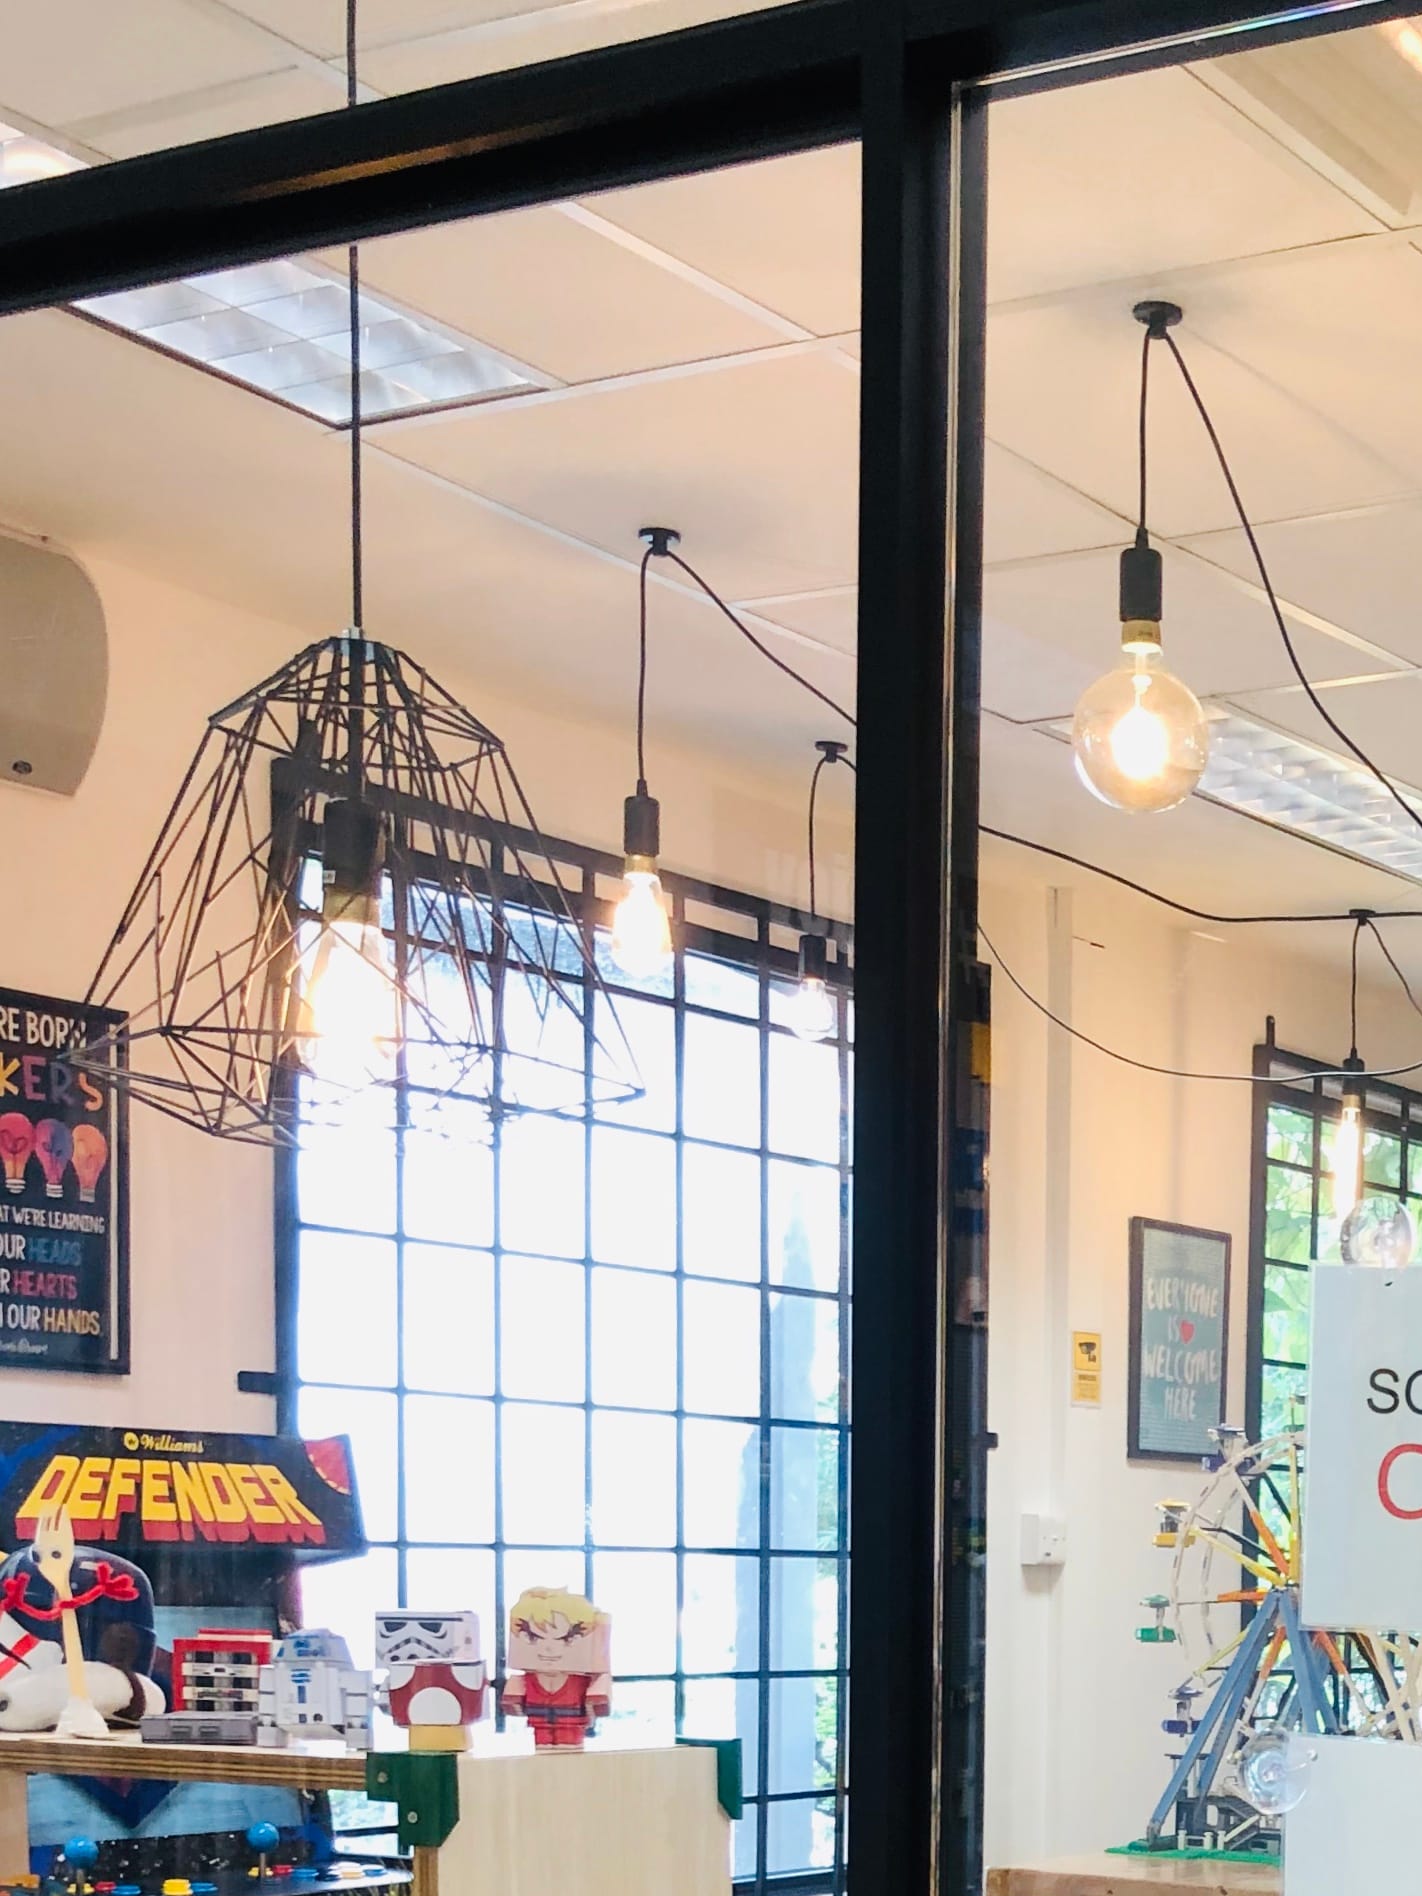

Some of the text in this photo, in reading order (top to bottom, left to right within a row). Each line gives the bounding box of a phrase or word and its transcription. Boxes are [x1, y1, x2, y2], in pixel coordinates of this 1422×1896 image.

[25, 1010, 87, 1049] BORN
[48, 1211, 105, 1234] LEARNING
[28, 1237, 82, 1266] HEADS
[13, 1270, 78, 1300] HEARTS
[1147, 1278, 1218, 1317] EVERYONE
[7, 1303, 41, 1331] OUR
[1170, 1316, 1181, 1342] IS
[1143, 1344, 1218, 1385] WELCOME
[1164, 1387, 1197, 1422] HERE
[140, 1433, 205, 1454] Williams
[16, 1455, 326, 1543] DEFENDER
